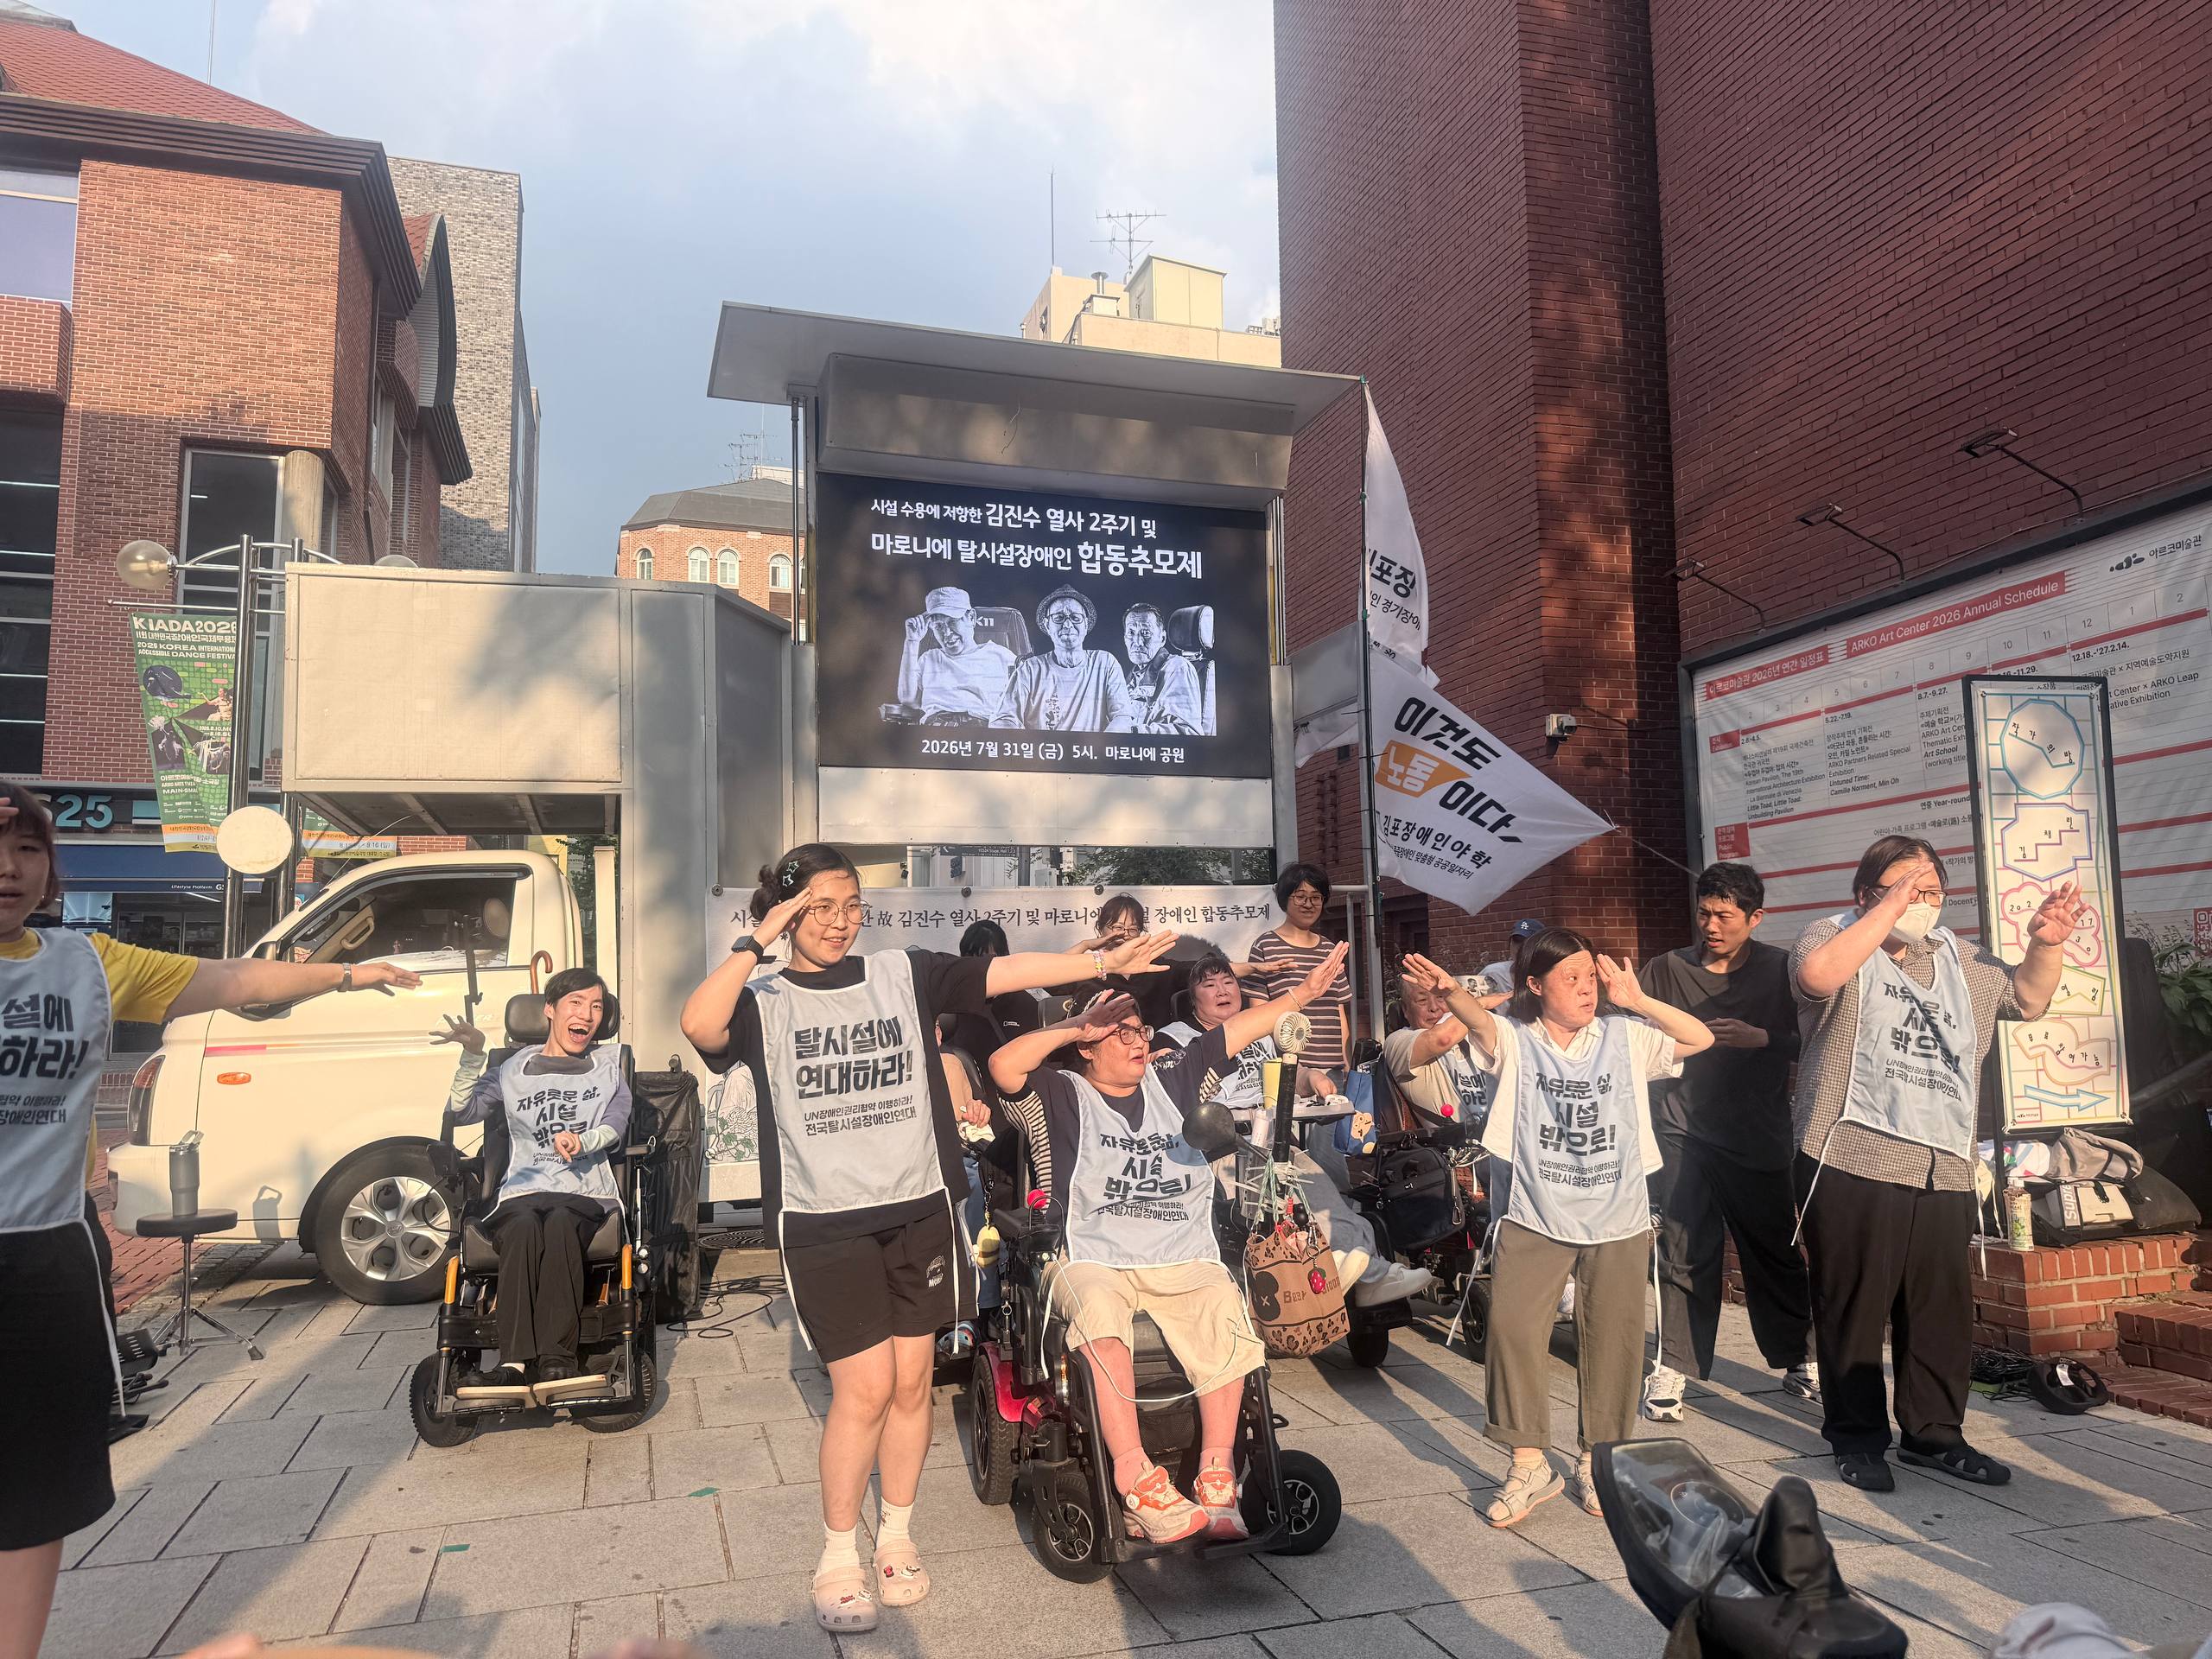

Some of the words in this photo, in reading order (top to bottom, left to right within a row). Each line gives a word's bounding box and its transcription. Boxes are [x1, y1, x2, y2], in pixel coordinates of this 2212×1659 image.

[871, 499, 898, 517] 시설
[900, 501, 940, 519] 수용에
[943, 505, 982, 524] 저항한
[985, 503, 1041, 529] 김진수
[1046, 508, 1084, 532] 열사
[1089, 512, 1135, 537] 2주기
[1141, 519, 1157, 539] 및
[871, 533, 951, 560] 마로니에
[957, 539, 1071, 571] 탈시설장애인
[1077, 541, 1202, 579] 합동추모제
[2149, 534, 2202, 560] 아르코미술관
[1851, 635, 1877, 652] ARKO
[1879, 632, 1894, 644] Art
[1897, 620, 1930, 638] Center
[1932, 609, 1961, 628] 2026
[1963, 599, 2002, 618] Annual
[2004, 580, 2059, 606] Schedule
[1894, 671, 1899, 679] 7
[1929, 662, 1935, 671] 8
[1966, 652, 1972, 660] 9
[2003, 640, 2013, 650] 10
[2043, 631, 2051, 639] 11
[2082, 619, 2093, 628] 12
[2130, 607, 2134, 615] 1
[2177, 593, 2183, 602] 2
[2072, 640, 2130, 663] 12.18.-'27.2.14.
[2126, 649, 2190, 671] 지역예술도약지원
[1709, 674, 1751, 695] 아르코미술관
[1751, 664, 1780, 683] 2026년
[1782, 659, 1797, 674] 연간
[1799, 651, 1824, 668] 일정표
[2113, 684, 2141, 698] Center
[2151, 677, 2175, 688] ARKO
[2177, 671, 2199, 684] Leap
[2130, 690, 2171, 705] Exhibition
[1395, 696, 1502, 771] 이건도
[1922, 728, 1940, 739] ARKO
[1941, 726, 1951, 734] Art
[1923, 737, 1952, 748] Thematic
[921, 740, 972, 757] 2026년
[976, 741, 999, 758] 7월
[1003, 742, 1033, 759] 31일
[1039, 743, 1064, 760] (금)
[1072, 745, 1097, 760] 5시.
[1105, 746, 1156, 762] 마로니에
[1160, 747, 1185, 763] 공원
[1828, 760, 1843, 769] ARKO
[1867, 751, 1888, 761] Related
[1889, 746, 1911, 757] Special
[1923, 750, 1934, 759] Art
[1935, 746, 1958, 757] School
[1925, 757, 1953, 769] (working
[1388, 746, 1440, 792] 노동
[1828, 768, 1854, 778] Exhibition
[1829, 778, 1853, 787] Untuned
[1383, 815, 1492, 869] 김포장애인야학
[1414, 851, 1435, 866] 맞춤형
[1434, 857, 1474, 880] 공공일자리
[877, 910, 893, 927] 故
[898, 910, 945, 929] 김진수
[950, 910, 982, 929] 열사
[984, 908, 1020, 927] 2주기
[1027, 907, 1039, 926] 및
[1154, 906, 1197, 924] 장애인
[1201, 904, 1270, 924] 합동추모제
[794, 1016, 903, 1059] 탈시설에
[796, 1050, 913, 1100] 연대하라!
[1535, 1072, 1593, 1100] 자유로운
[517, 1089, 578, 1112] 자유로운
[804, 1102, 876, 1122] UN장애인권리협약
[878, 1095, 913, 1110] 이행하라!
[536, 1103, 578, 1127] 시설
[805, 1106, 917, 1136] 전국탈시설장애인연대
[1554, 1101, 1599, 1128] 시설
[1539, 1123, 1616, 1156] 밖으로!
